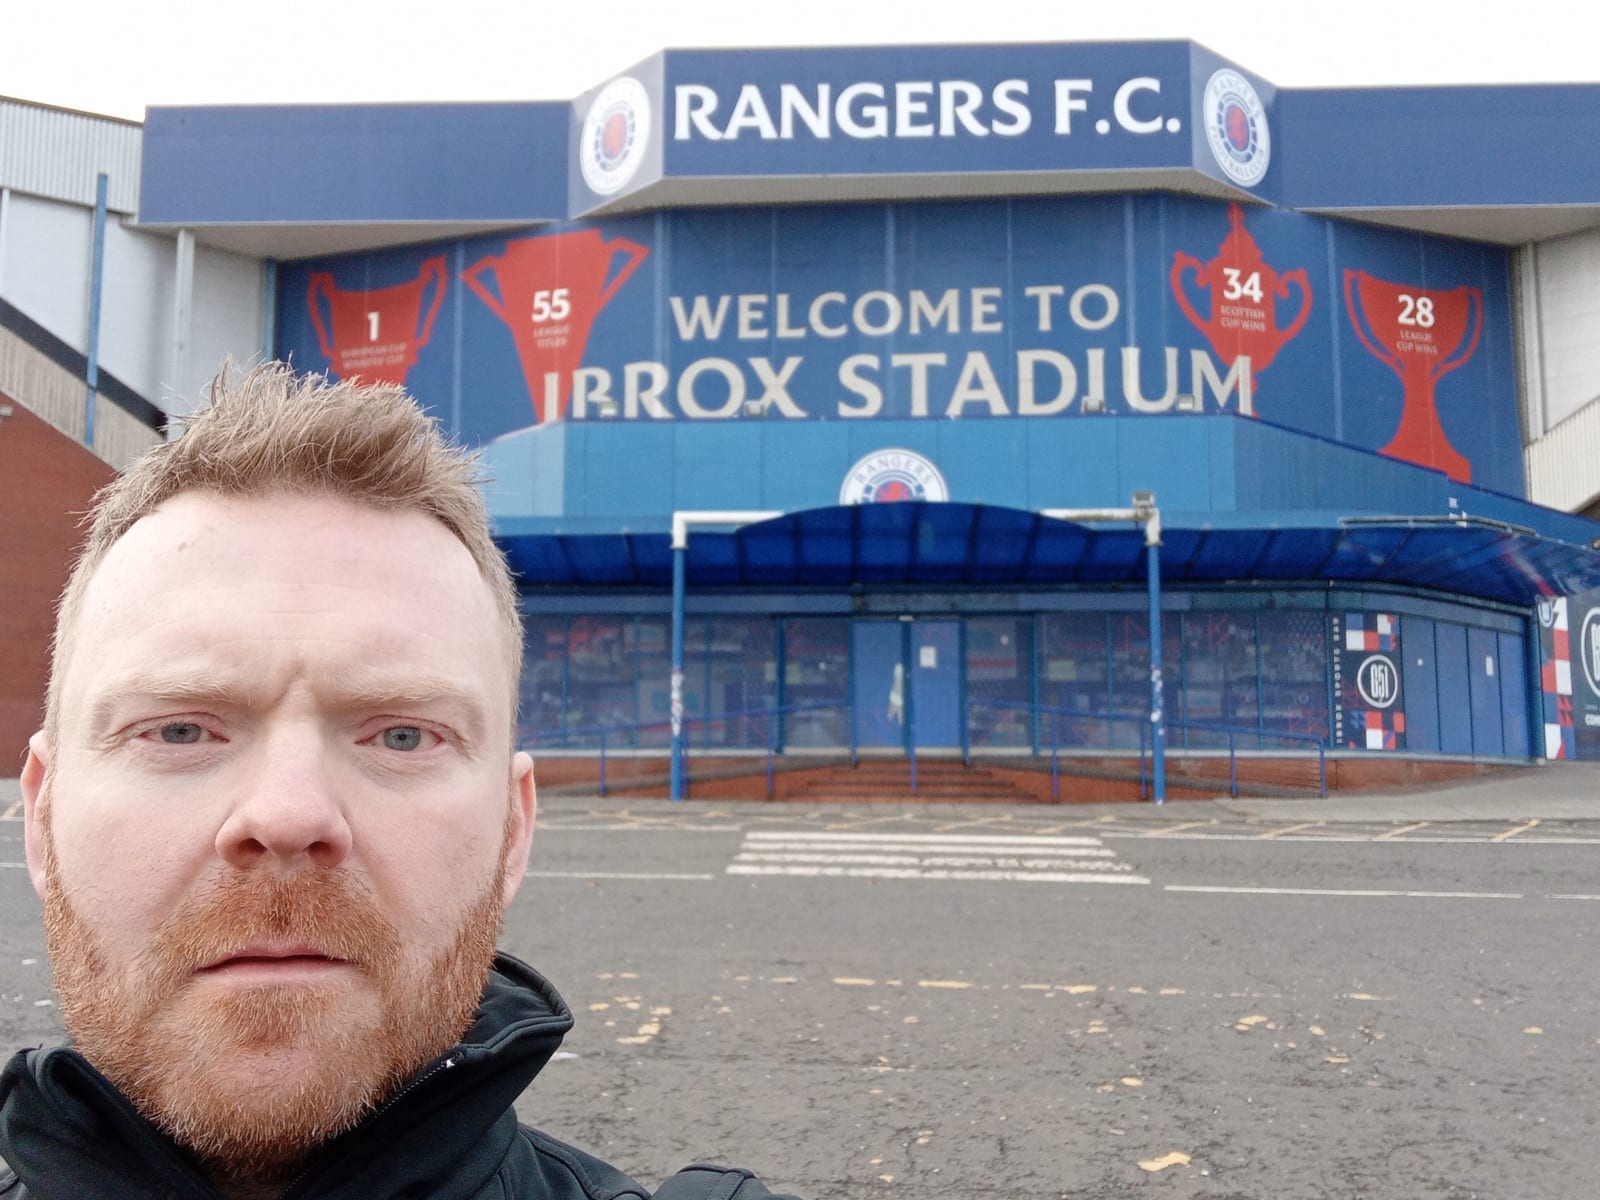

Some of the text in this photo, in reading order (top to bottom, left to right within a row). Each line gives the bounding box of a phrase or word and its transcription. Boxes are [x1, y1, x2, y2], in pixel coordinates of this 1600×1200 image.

[673, 79, 1032, 141] RANGERS
[1053, 76, 1182, 135] F.C.
[1222, 267, 1264, 304] 34
[531, 288, 570, 323] 55
[669, 283, 1120, 341] WELCOME TO
[1398, 294, 1435, 328] 28
[367, 311, 379, 341] 1
[1400, 330, 1433, 343] LEAGUE
[1396, 340, 1438, 356] CUP WINS
[543, 347, 1253, 421] IBROX STADIUM
[855, 455, 934, 485] RANGERS
